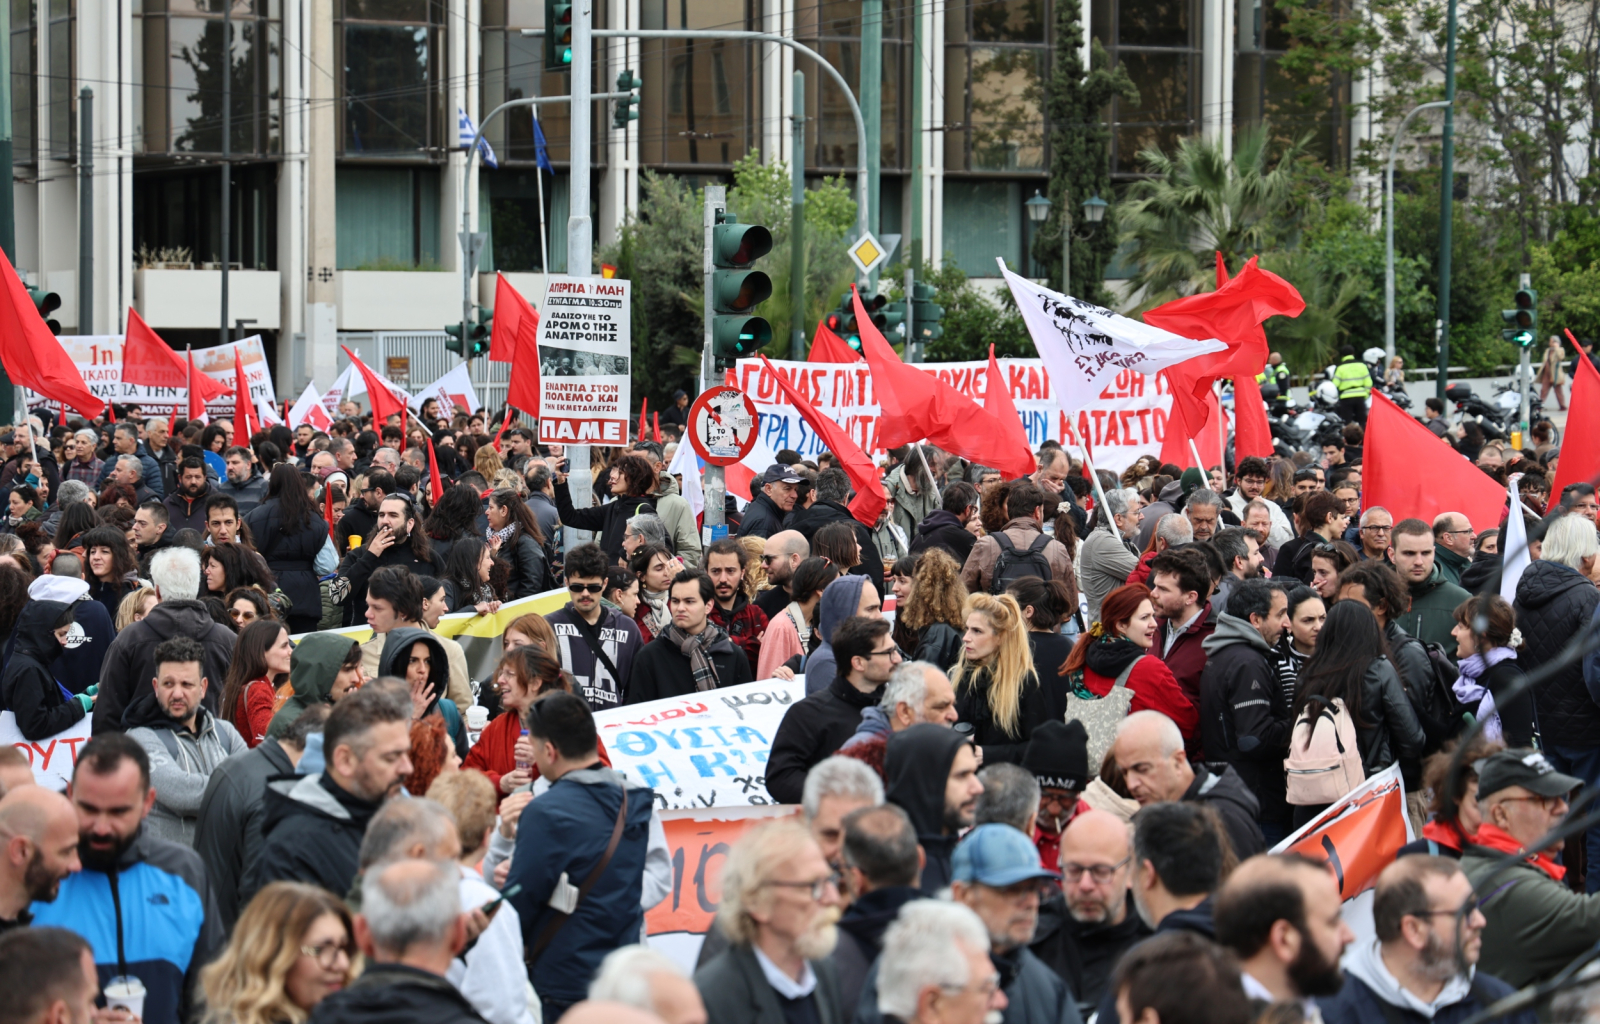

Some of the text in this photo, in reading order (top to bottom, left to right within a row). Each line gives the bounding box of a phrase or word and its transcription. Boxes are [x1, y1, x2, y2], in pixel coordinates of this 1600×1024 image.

[549, 283, 585, 293] ΑΠΕΡΓΙΑ
[596, 285, 624, 296] ΜΑΗ
[548, 297, 587, 306] ΣΥΝΤΑΓΜΑ
[551, 312, 596, 320] ΒΑΔΙΖΟΥΜΕ
[545, 320, 618, 332] ΔΡΟΜΟ ΤΗΣ
[545, 331, 618, 342] ΑΝΑΤΡΟΠΗΣ
[89, 344, 113, 366] 1η
[79, 369, 119, 381] ΙΚΑΓΟ
[545, 382, 619, 393] ΕΝΑΝΤΙΑ ΣΤΟΝ
[1008, 364, 1050, 399] ΚΑΙ
[545, 391, 619, 403] ΠΟΛΕΜΟ ΚΑΙ
[556, 404, 618, 412] ΕΚΜΕΤΑΛΛΕΥΣΗ
[541, 419, 621, 441] ΠΑΜΕ
[757, 412, 789, 452] ΤΡΑ
[1017, 411, 1048, 444] ΗΝ
[1059, 407, 1169, 446] ΚΑΤΑΣΤΟ
